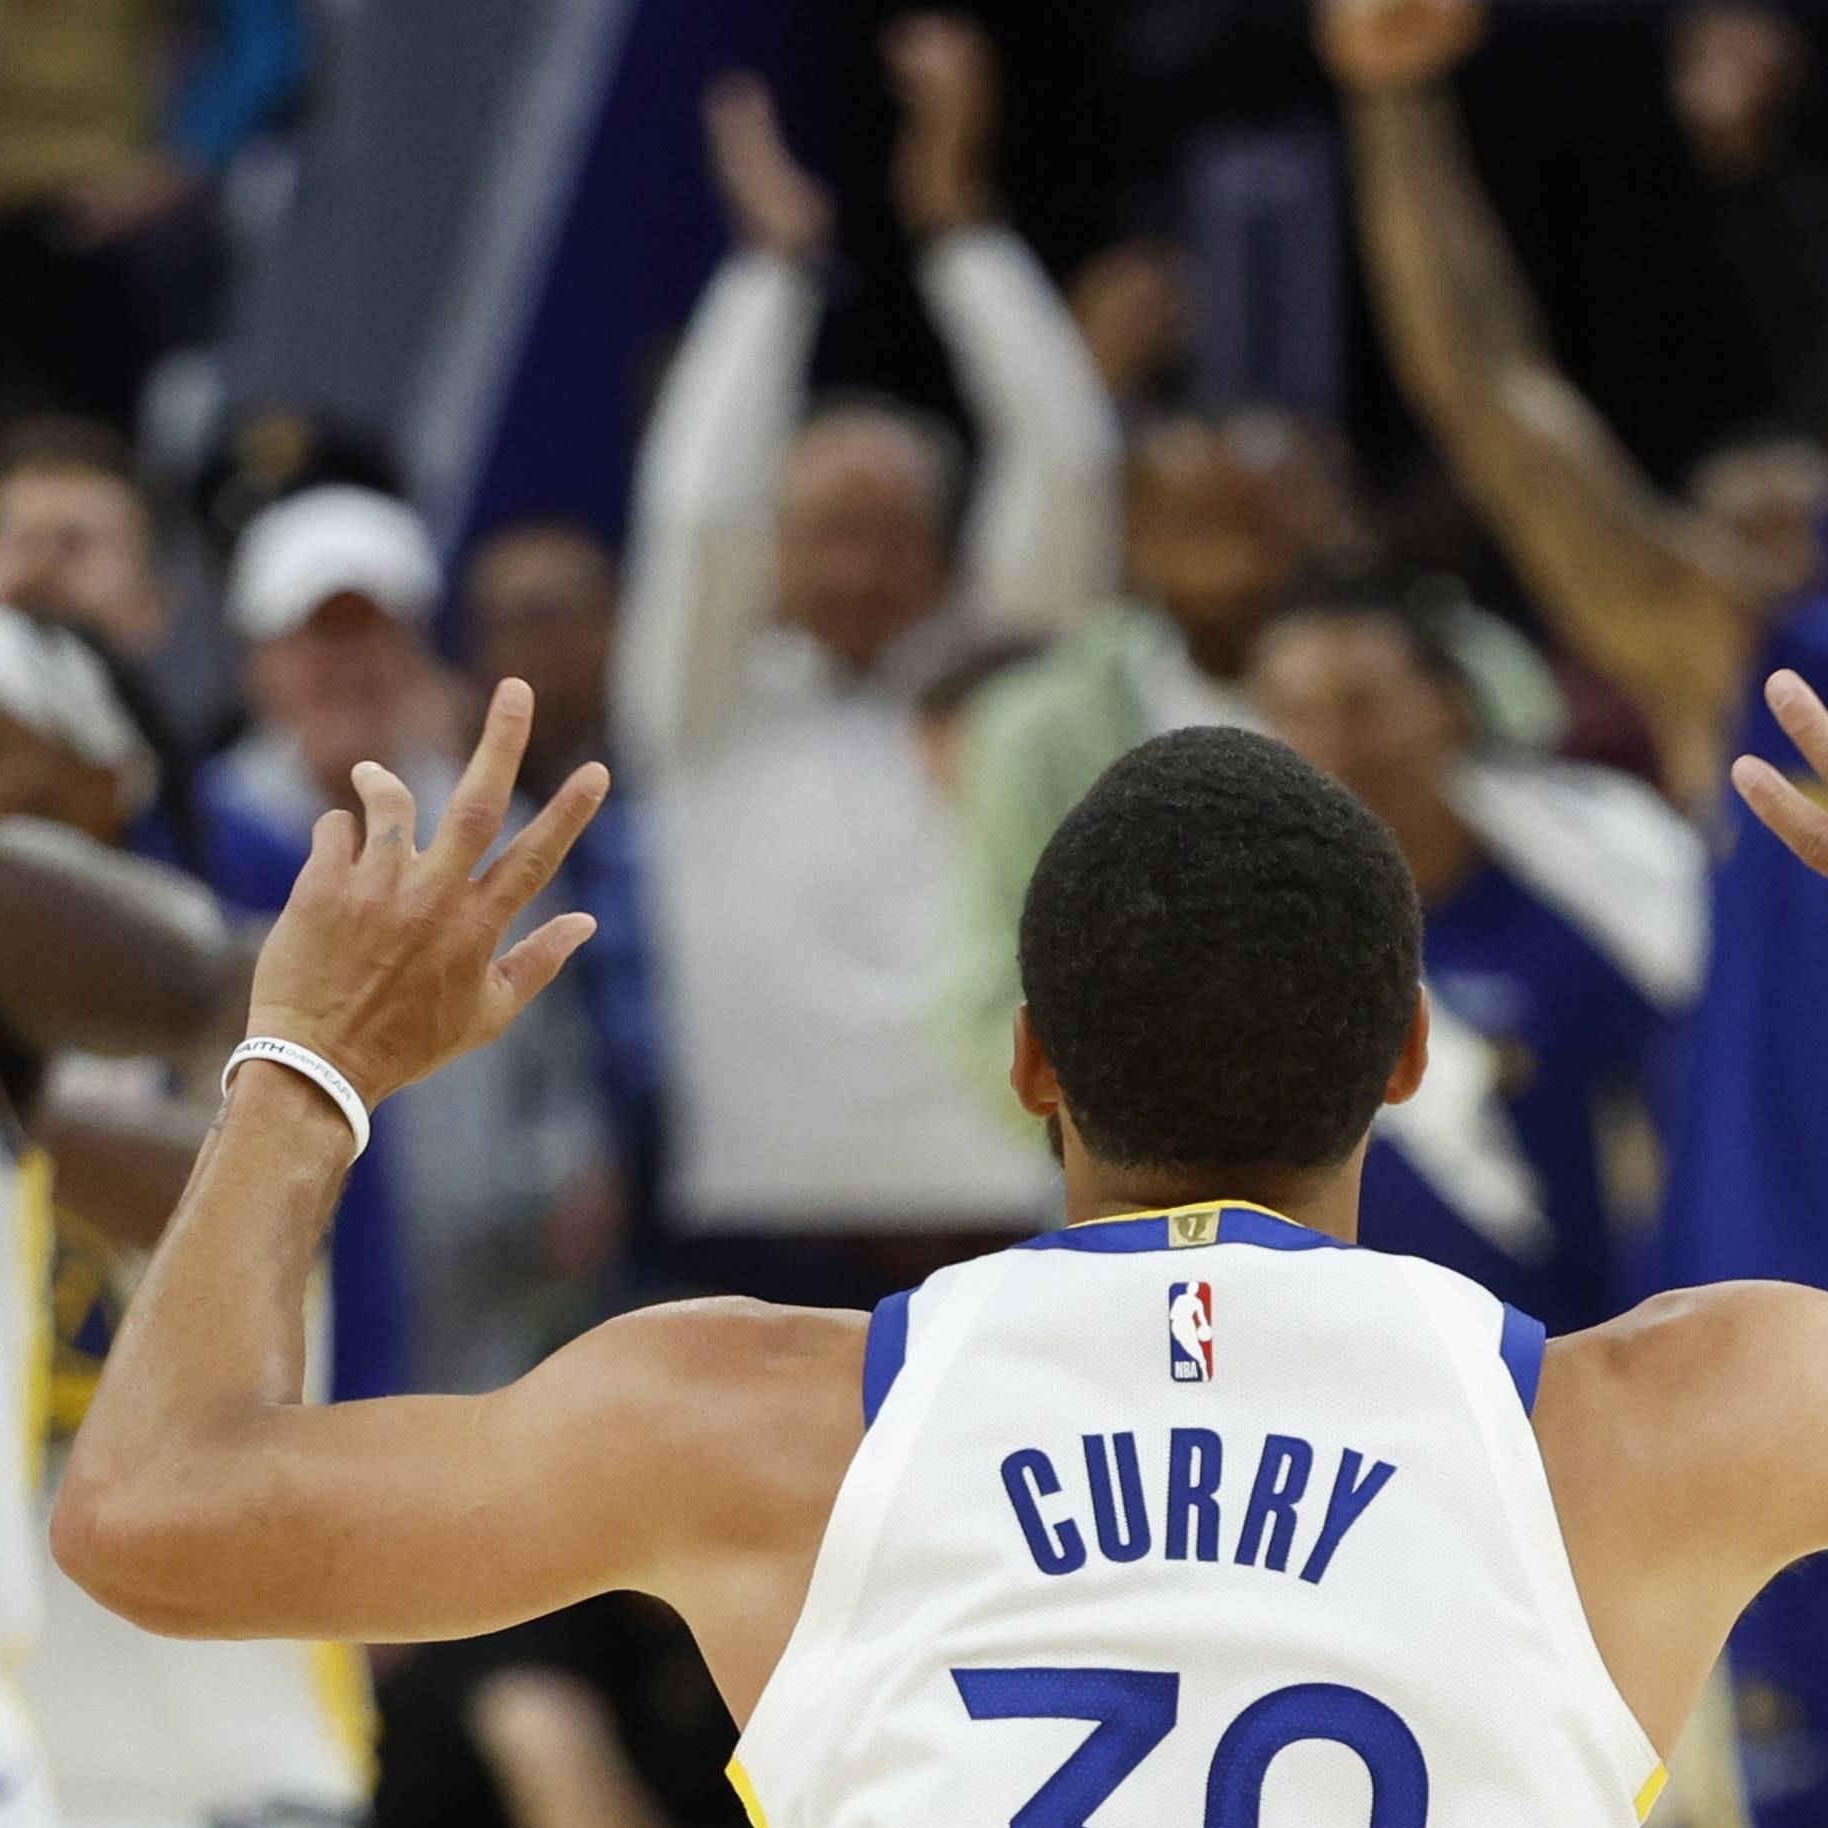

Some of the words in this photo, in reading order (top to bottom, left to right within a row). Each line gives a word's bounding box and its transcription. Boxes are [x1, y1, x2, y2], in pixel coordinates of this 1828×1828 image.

[315, 1062, 352, 1102] FEAR
[1174, 1360, 1198, 1379] NBA
[1001, 1427, 1397, 1585] CURRY
